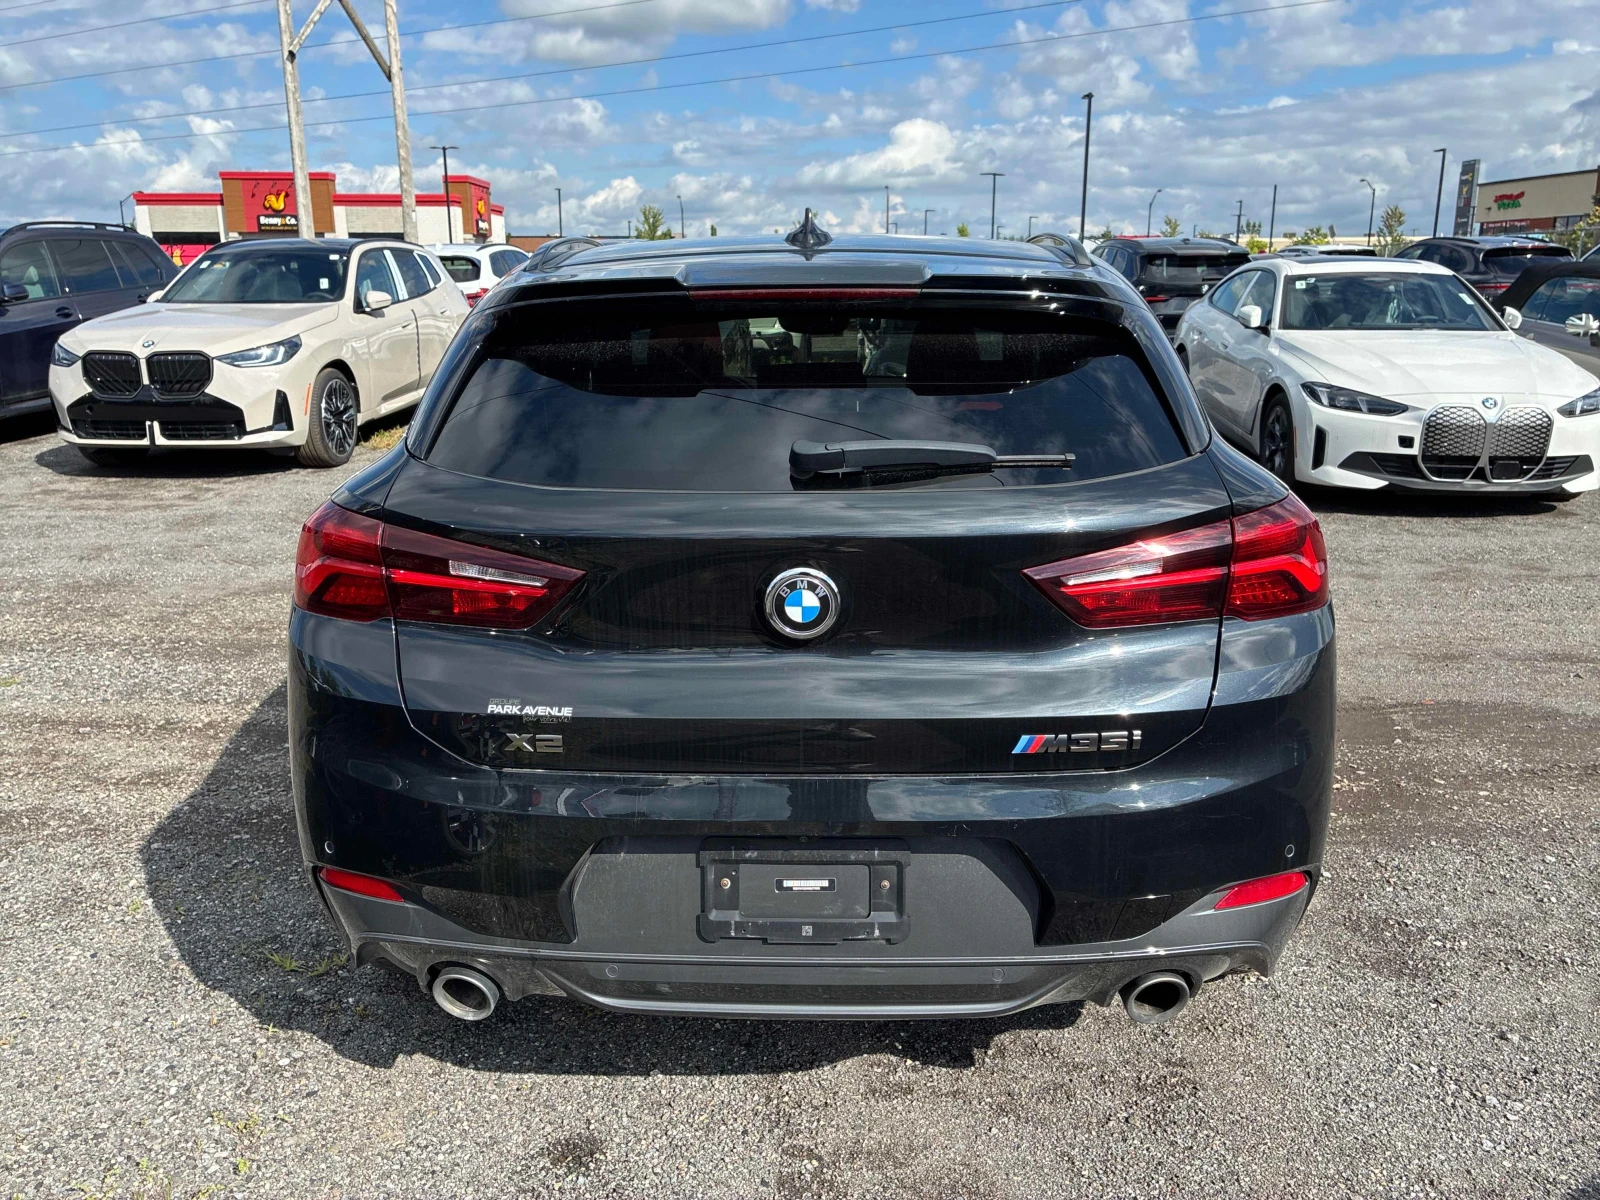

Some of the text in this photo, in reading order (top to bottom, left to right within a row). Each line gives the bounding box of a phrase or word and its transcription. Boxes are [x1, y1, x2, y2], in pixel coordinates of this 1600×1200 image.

[779, 579, 827, 598] BMW
[487, 704, 573, 716] PARK AVENUE
[503, 732, 564, 753] X2
[1033, 729, 1142, 754] M35i
